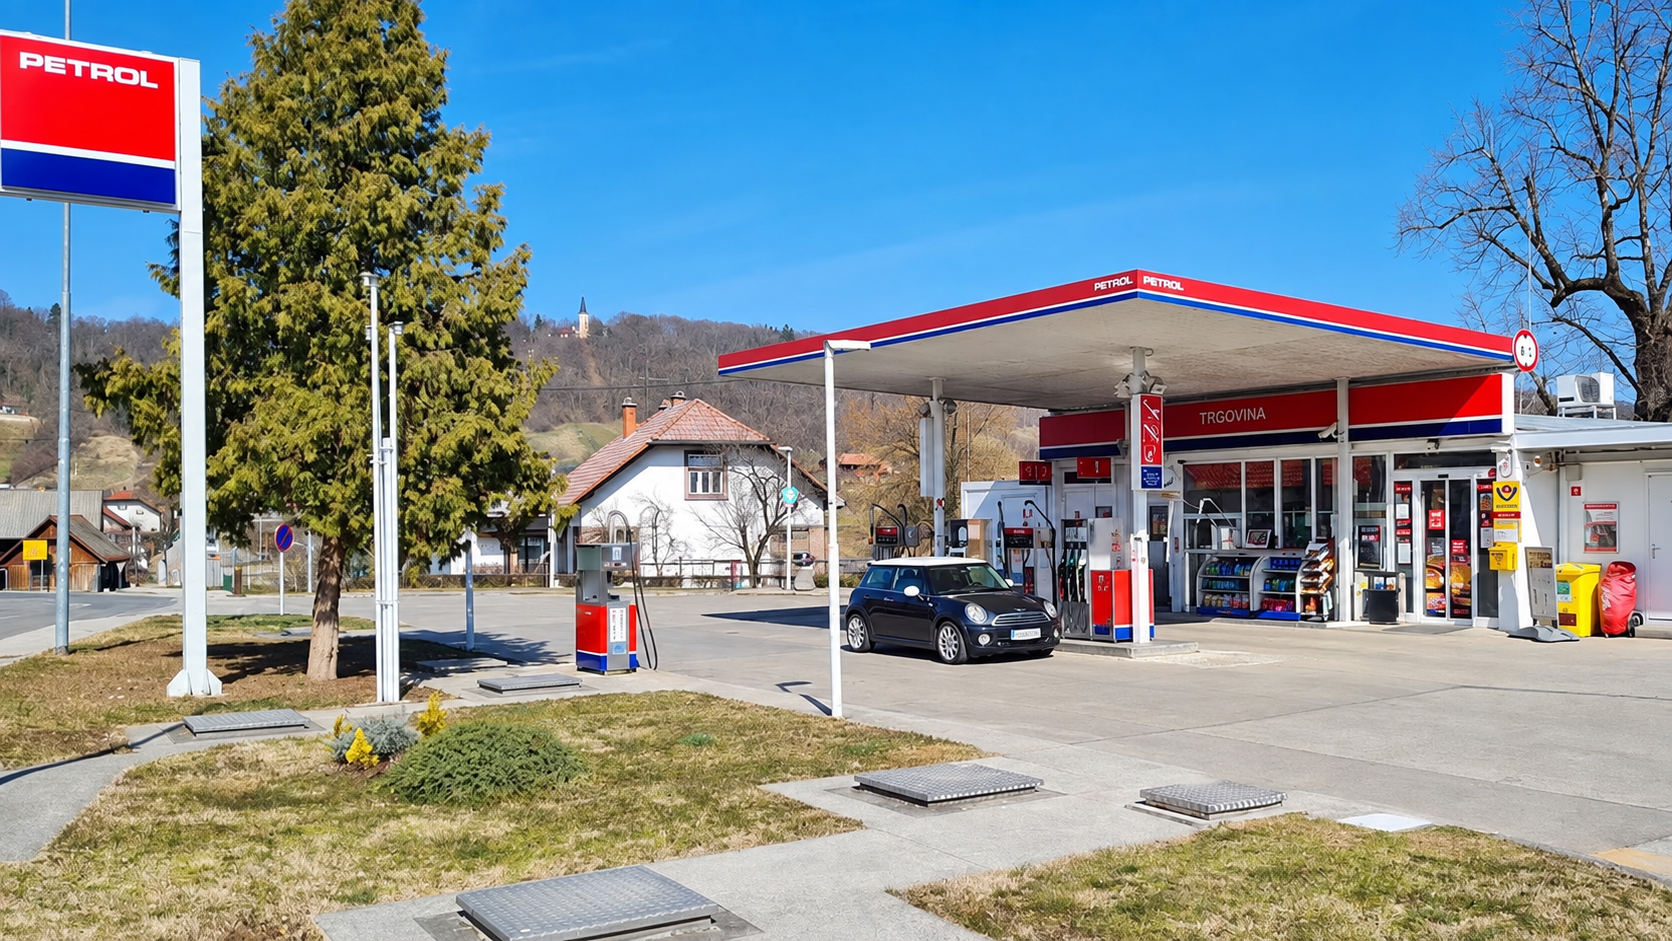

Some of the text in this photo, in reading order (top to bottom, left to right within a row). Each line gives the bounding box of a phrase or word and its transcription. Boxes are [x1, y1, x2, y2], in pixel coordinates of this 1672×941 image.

[19, 51, 159, 89] PETROL
[1094, 276, 1133, 291] PETROL
[1143, 275, 1184, 291] PETROL
[1199, 407, 1266, 425] TRGOVINA
